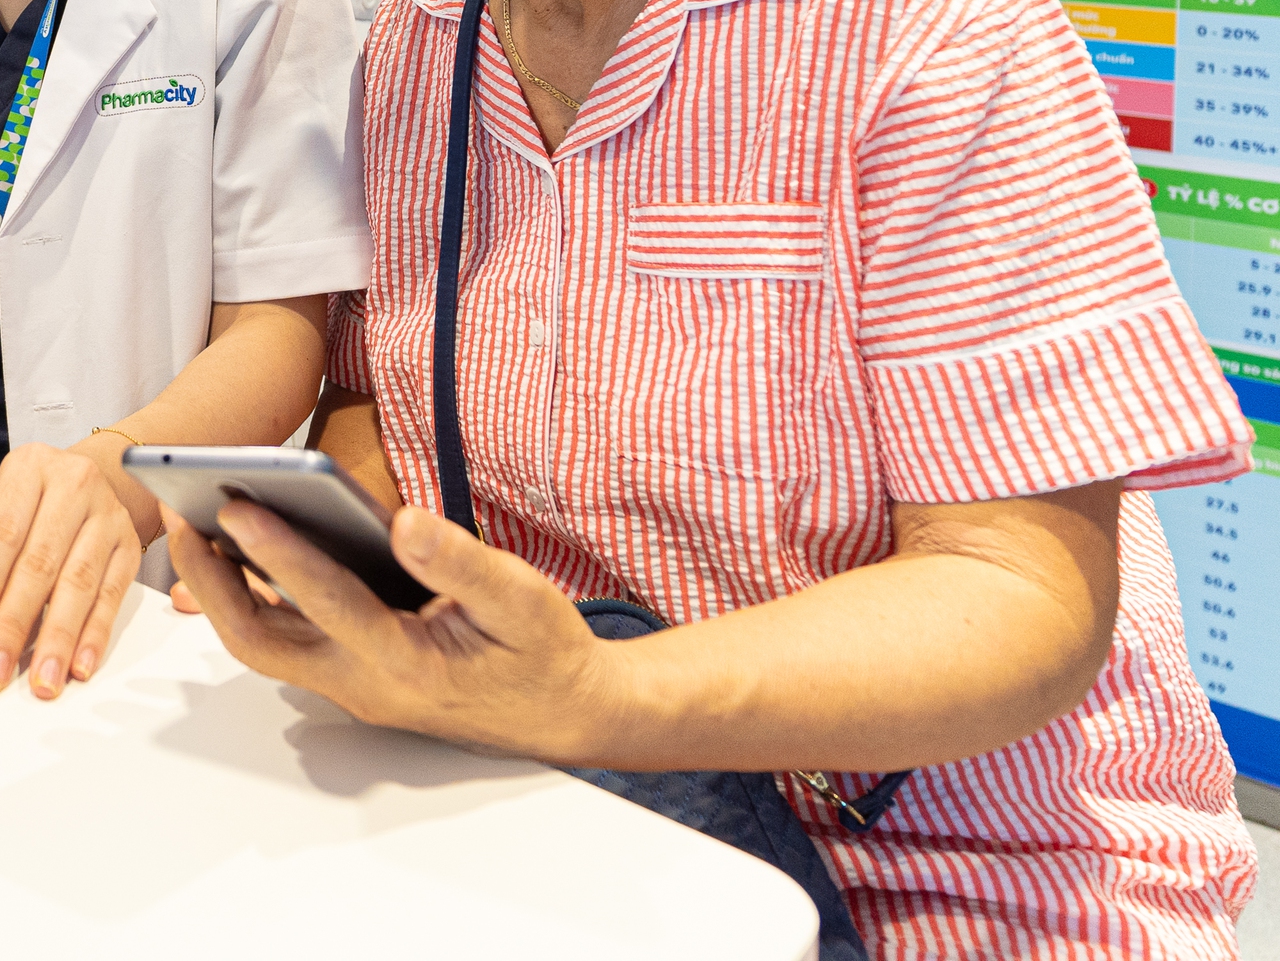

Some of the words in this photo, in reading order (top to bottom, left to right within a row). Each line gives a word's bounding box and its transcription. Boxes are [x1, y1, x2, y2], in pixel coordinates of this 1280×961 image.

[1197, 25, 1208, 37] 0
[1223, 26, 1261, 42] 20%
[1196, 61, 1217, 75] 21
[1230, 63, 1271, 80] 34%
[101, 79, 197, 111] Pharmacity
[1194, 98, 1217, 112] 35
[1230, 101, 1270, 118] 39%
[1193, 135, 1216, 148] 40
